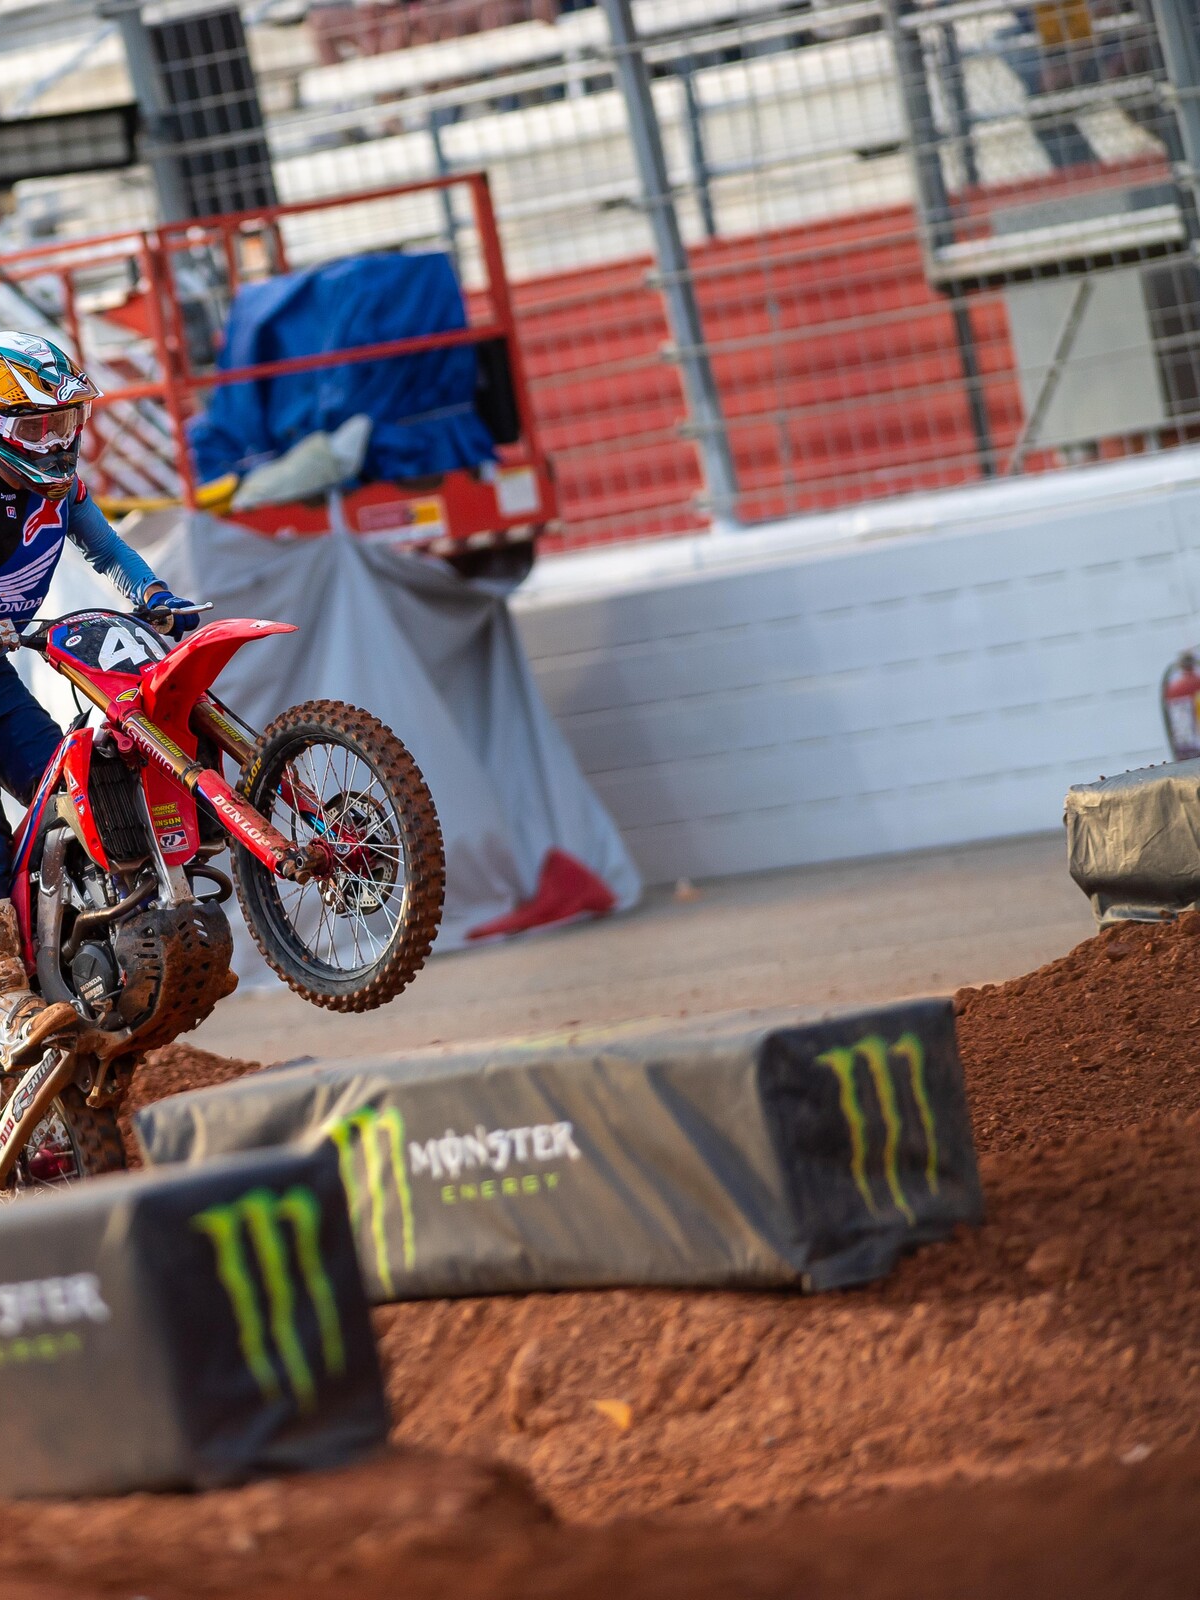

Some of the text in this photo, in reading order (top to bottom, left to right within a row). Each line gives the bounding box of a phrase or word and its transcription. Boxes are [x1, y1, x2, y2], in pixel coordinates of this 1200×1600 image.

[98, 626, 167, 672] 41
[211, 793, 272, 847] DUNLOP
[80, 975, 103, 993] HONDA
[11, 1049, 61, 1123] RENTHAL
[407, 1120, 582, 1181] MONSTER
[440, 1171, 560, 1206] ENERGY
